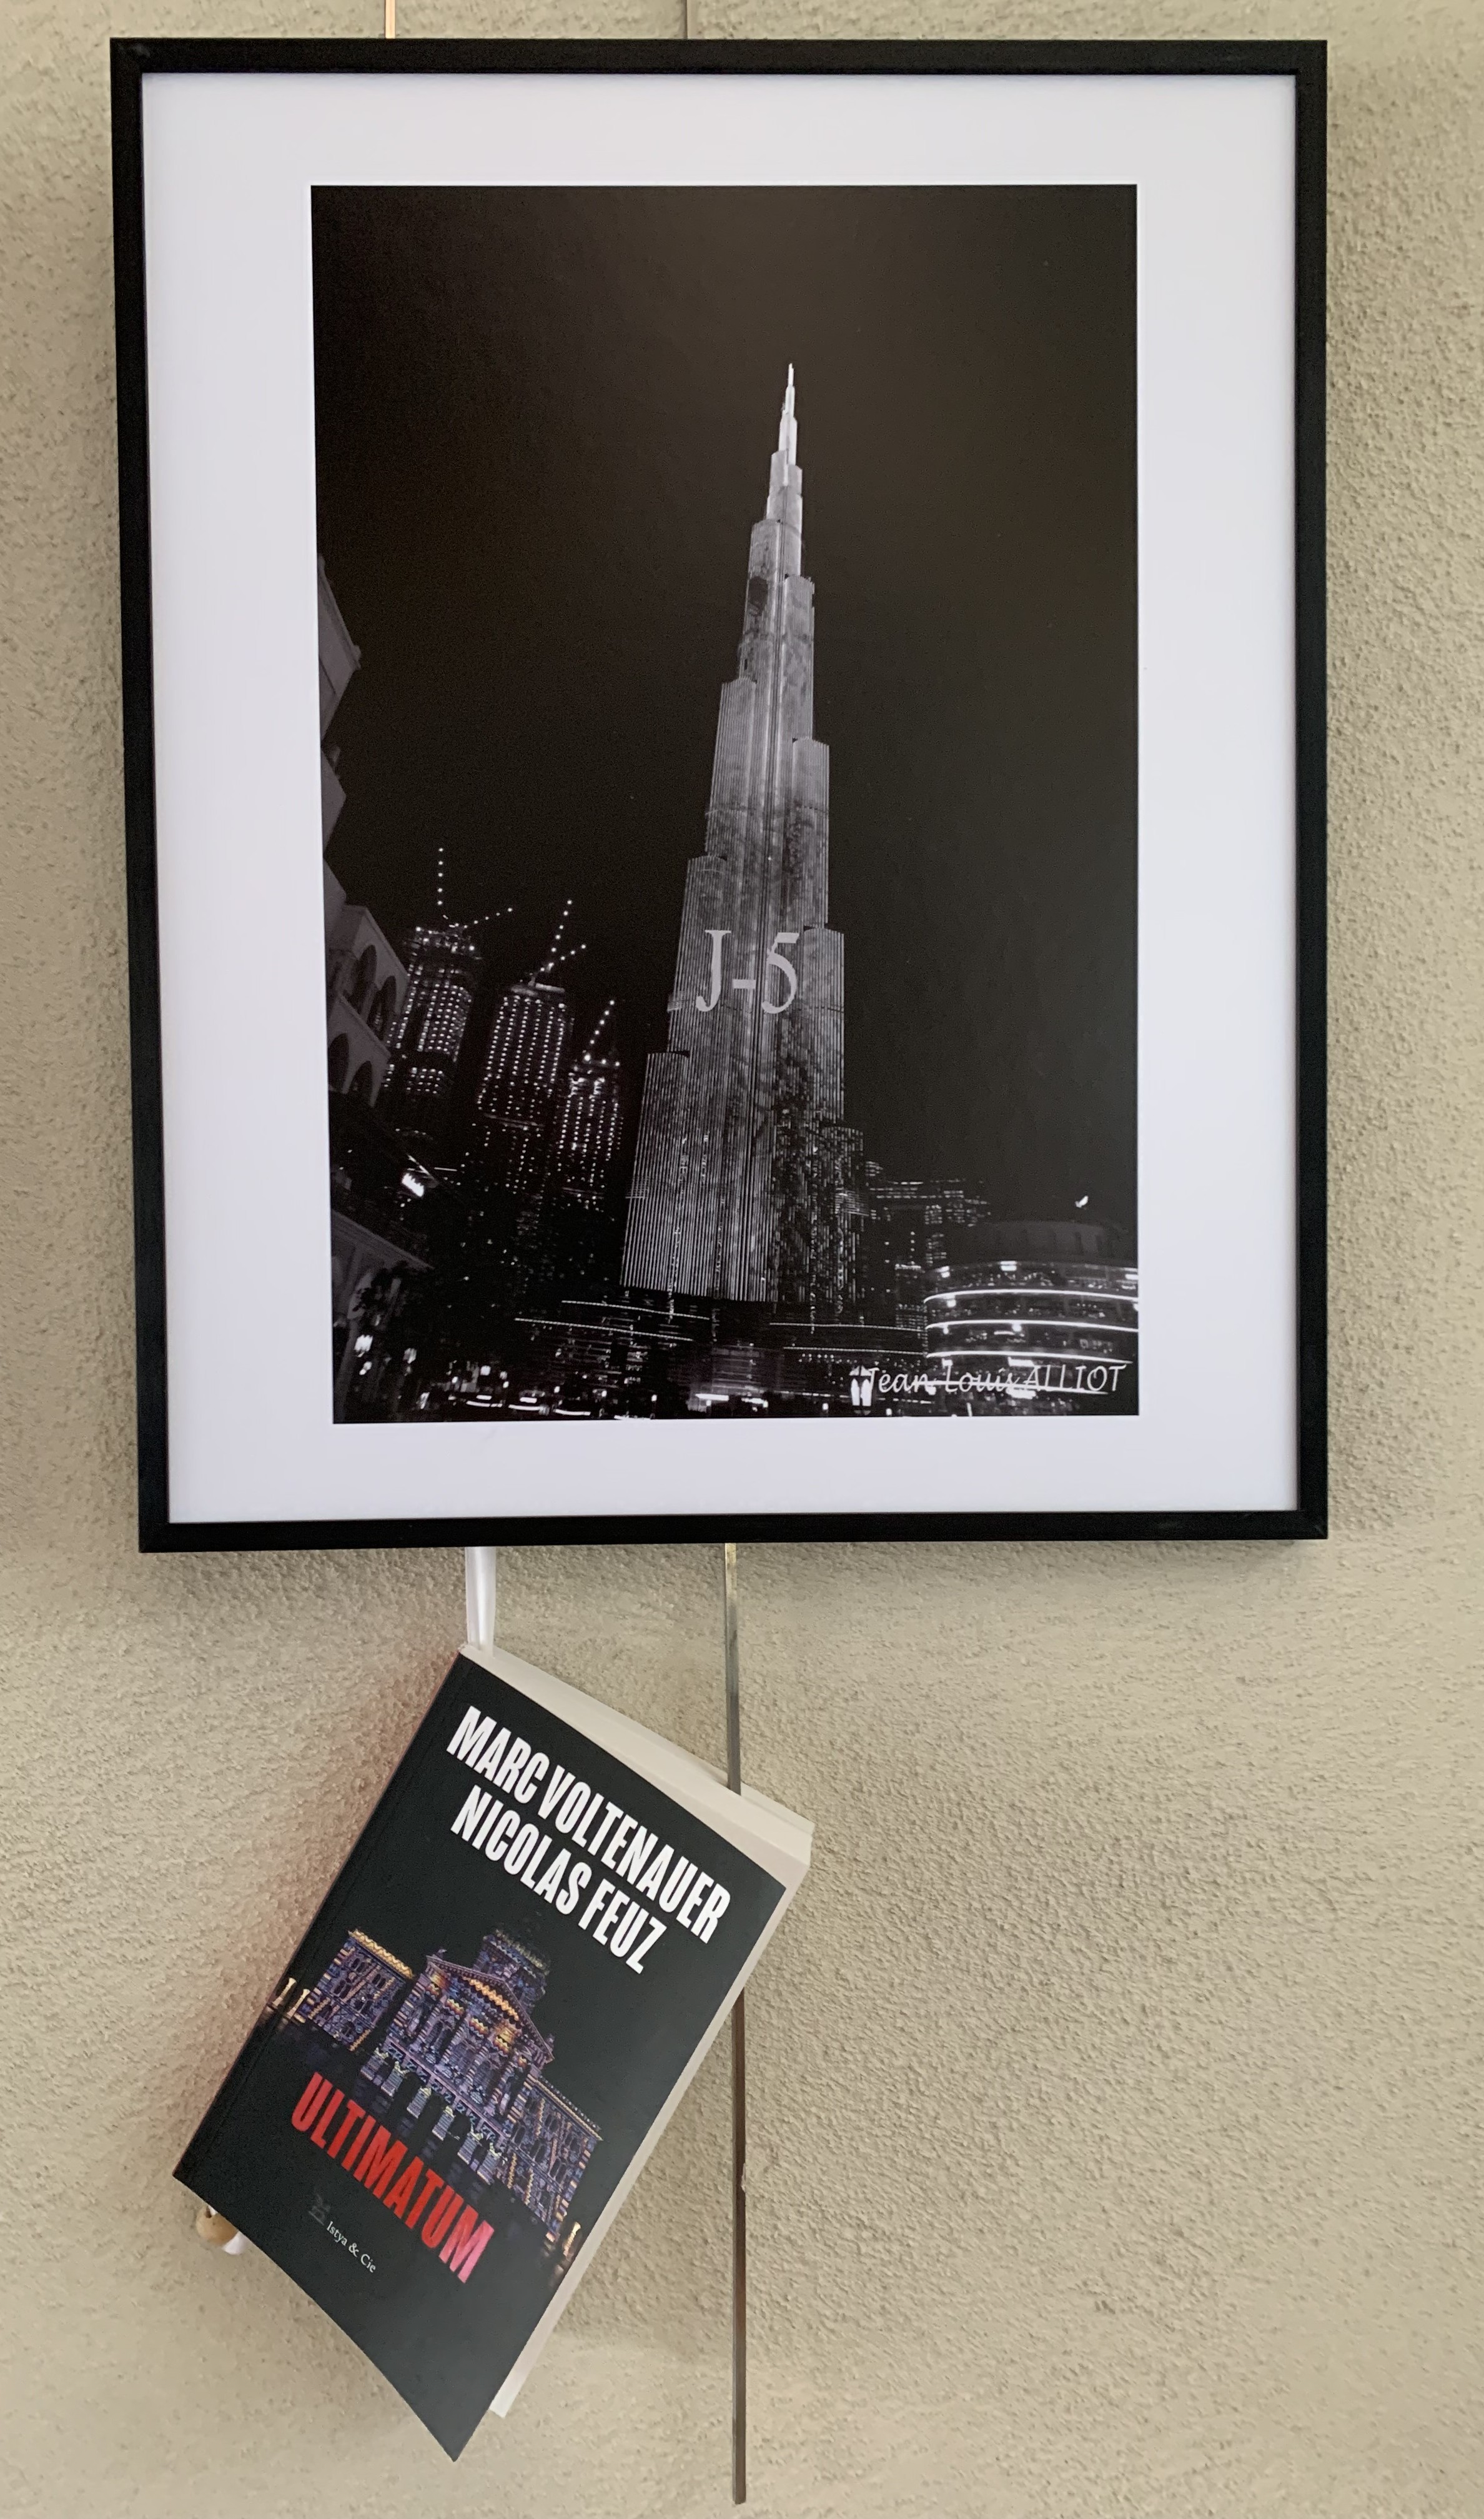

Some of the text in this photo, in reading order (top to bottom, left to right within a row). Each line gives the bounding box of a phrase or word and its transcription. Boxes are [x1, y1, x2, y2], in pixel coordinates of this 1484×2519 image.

[696, 929, 799, 1014] J-5
[446, 1705, 731, 1944] MARC VOLTENAUER
[450, 1784, 668, 1974] NICOLAS FEUZ
[291, 2071, 495, 2284] ULTIMATUM
[327, 2220, 376, 2273] Istya & Cie
